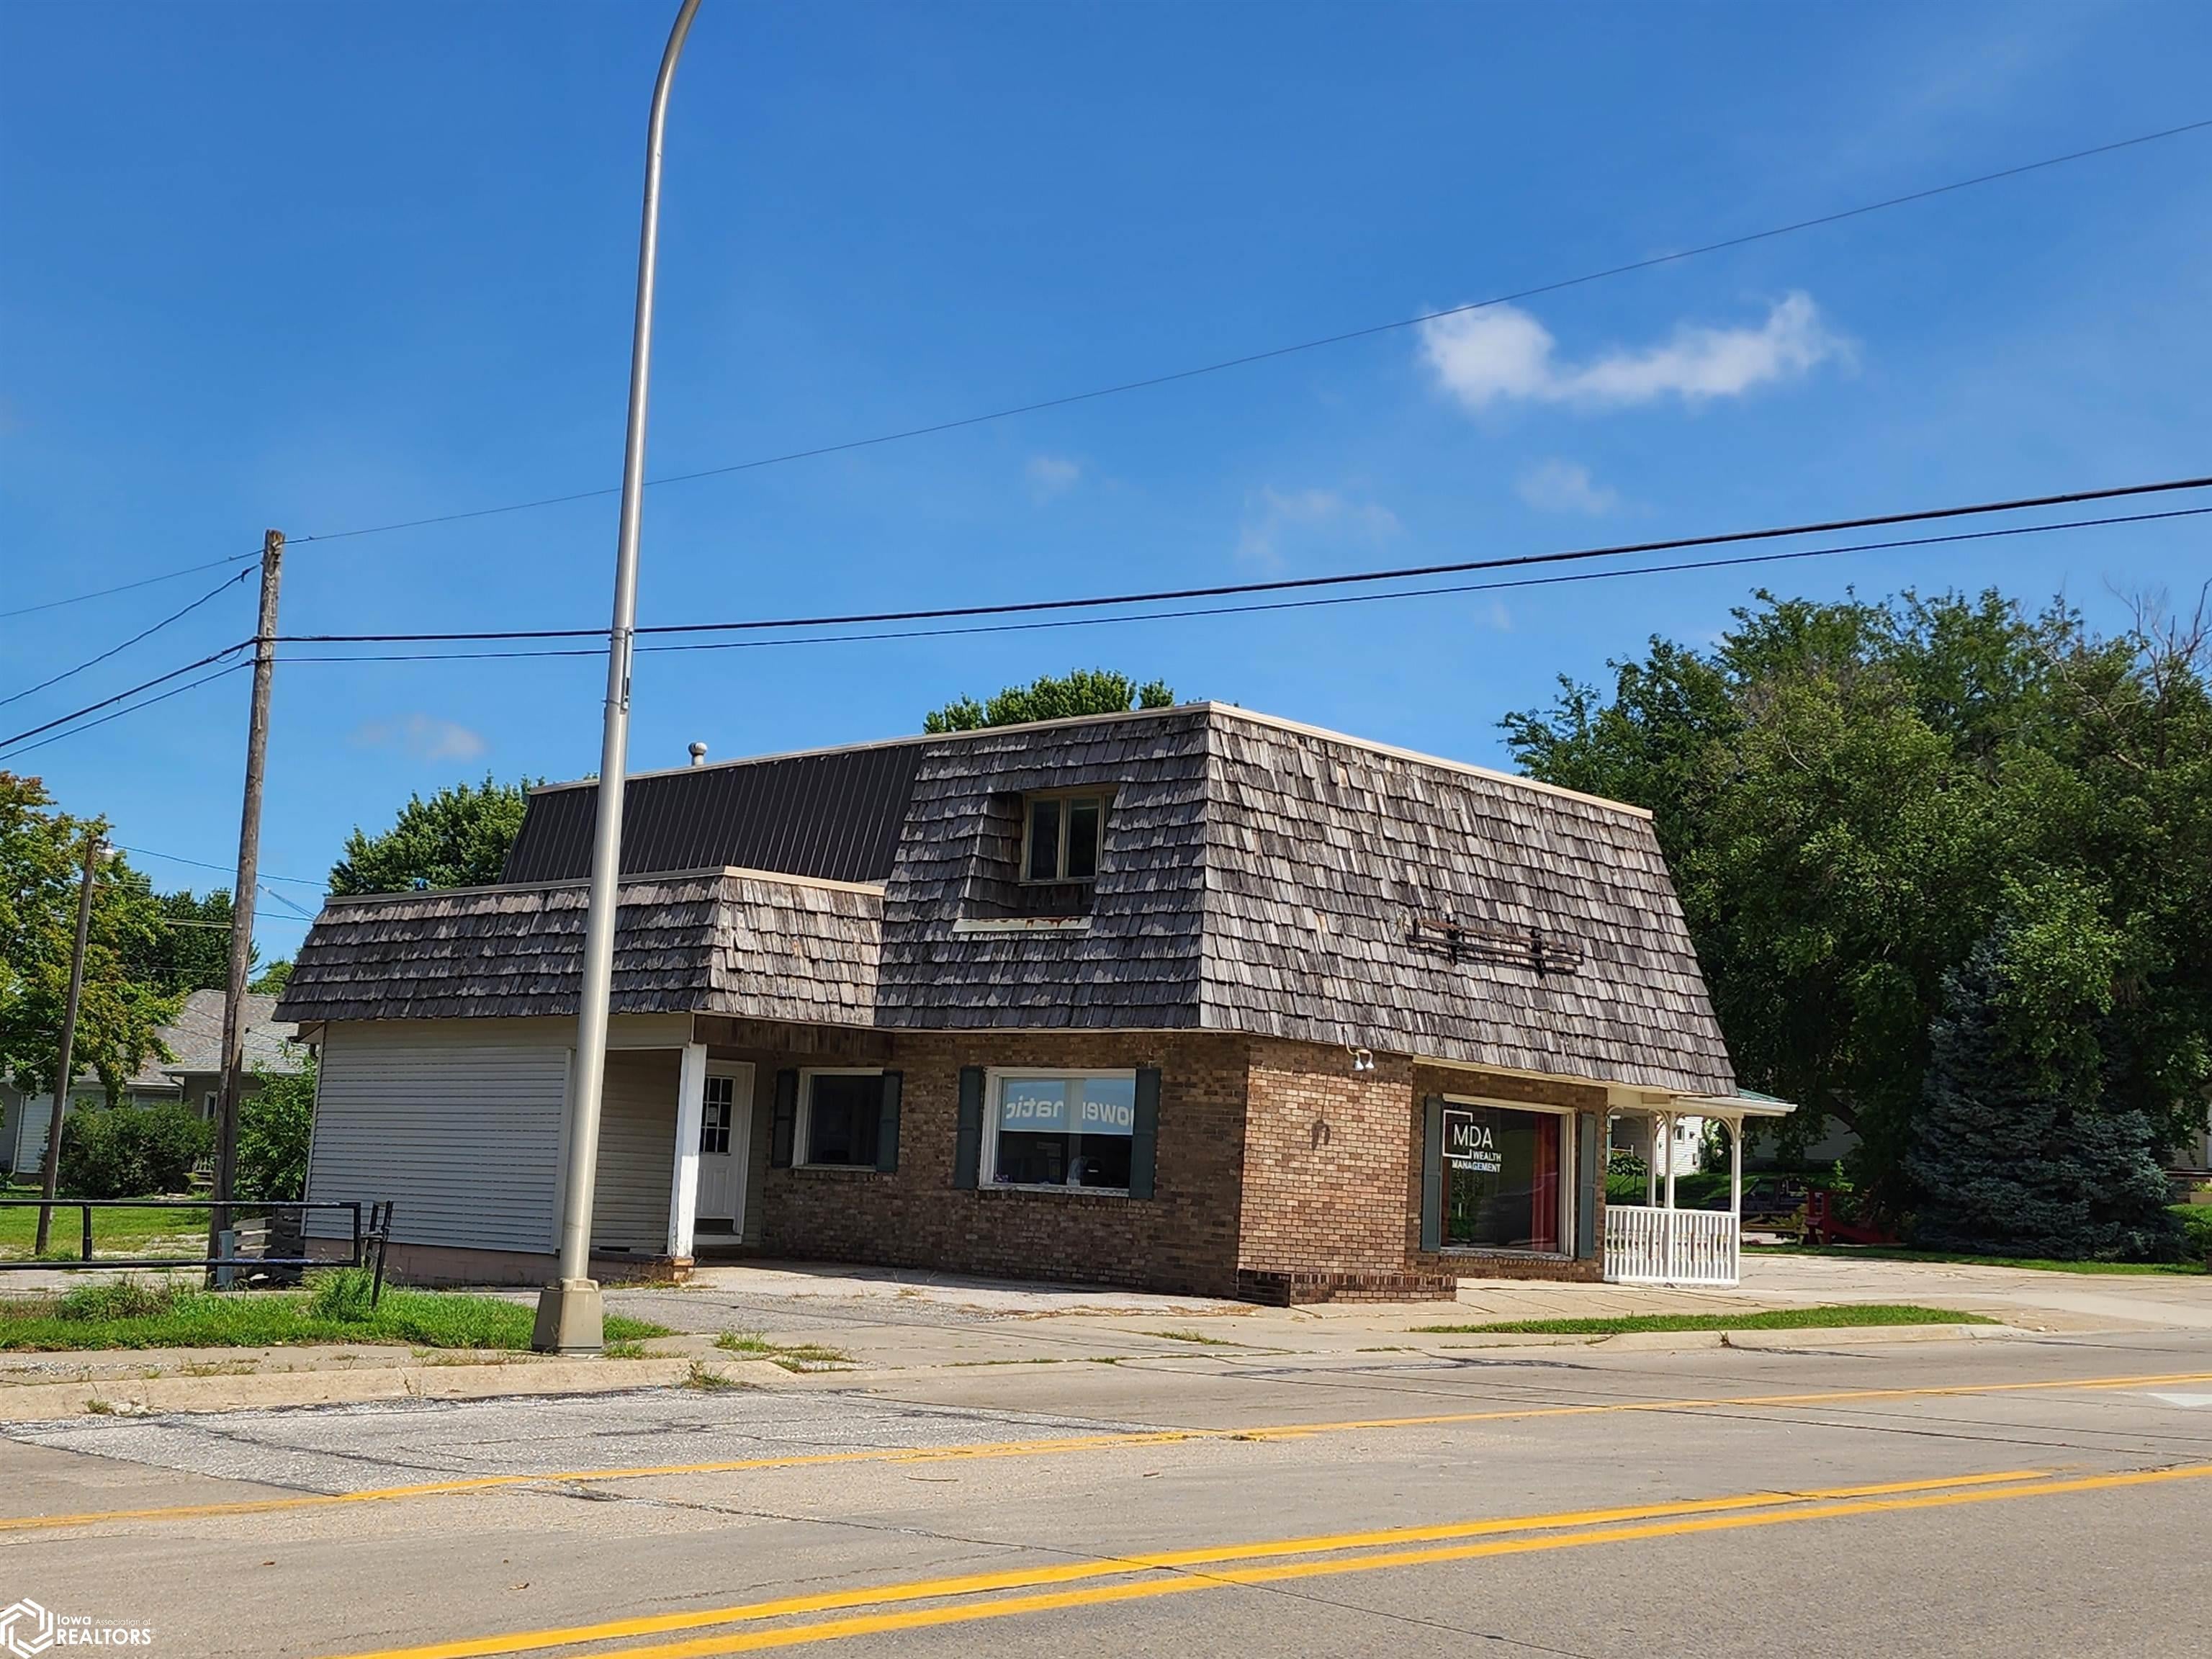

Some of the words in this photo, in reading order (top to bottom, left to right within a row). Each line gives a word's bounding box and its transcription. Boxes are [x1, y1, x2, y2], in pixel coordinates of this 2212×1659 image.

[1453, 1123, 1494, 1149] MDA
[1473, 1150, 1502, 1162] WEALTH
[1451, 1159, 1502, 1173] MANAGEMENT
